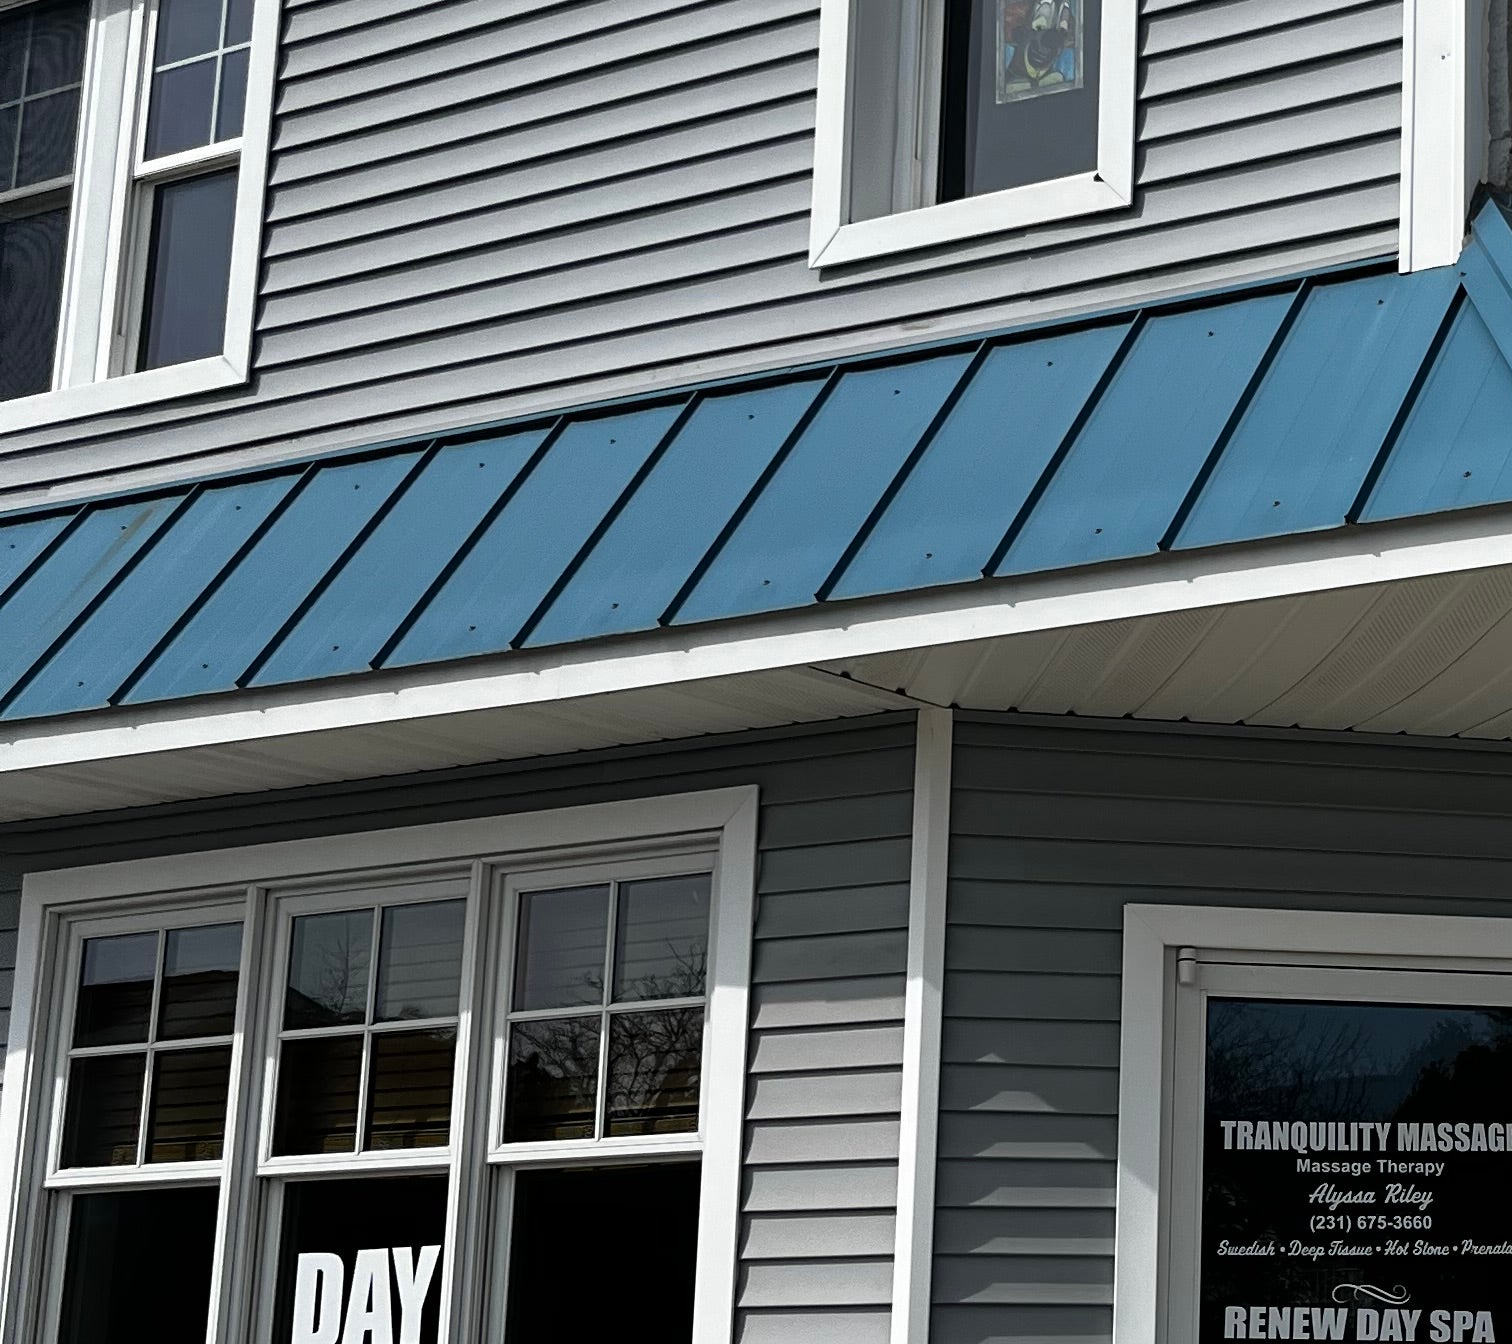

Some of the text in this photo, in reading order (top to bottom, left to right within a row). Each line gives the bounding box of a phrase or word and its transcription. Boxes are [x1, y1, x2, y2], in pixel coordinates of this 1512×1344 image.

[1221, 1121, 1391, 1154] TRANQUILITY
[1297, 1159, 1444, 1176] Massage Therapy
[1309, 1183, 1433, 1210] Alyssa Riley
[1310, 1216, 1432, 1233] (231) 675-3660
[1217, 1240, 1275, 1255] Swedish
[1288, 1240, 1325, 1261] Deep
[1328, 1240, 1372, 1256] Tissue
[1384, 1240, 1409, 1255] Hot
[1413, 1240, 1449, 1255] Stone
[1224, 1306, 1495, 1343] RENEW DAY SPA
